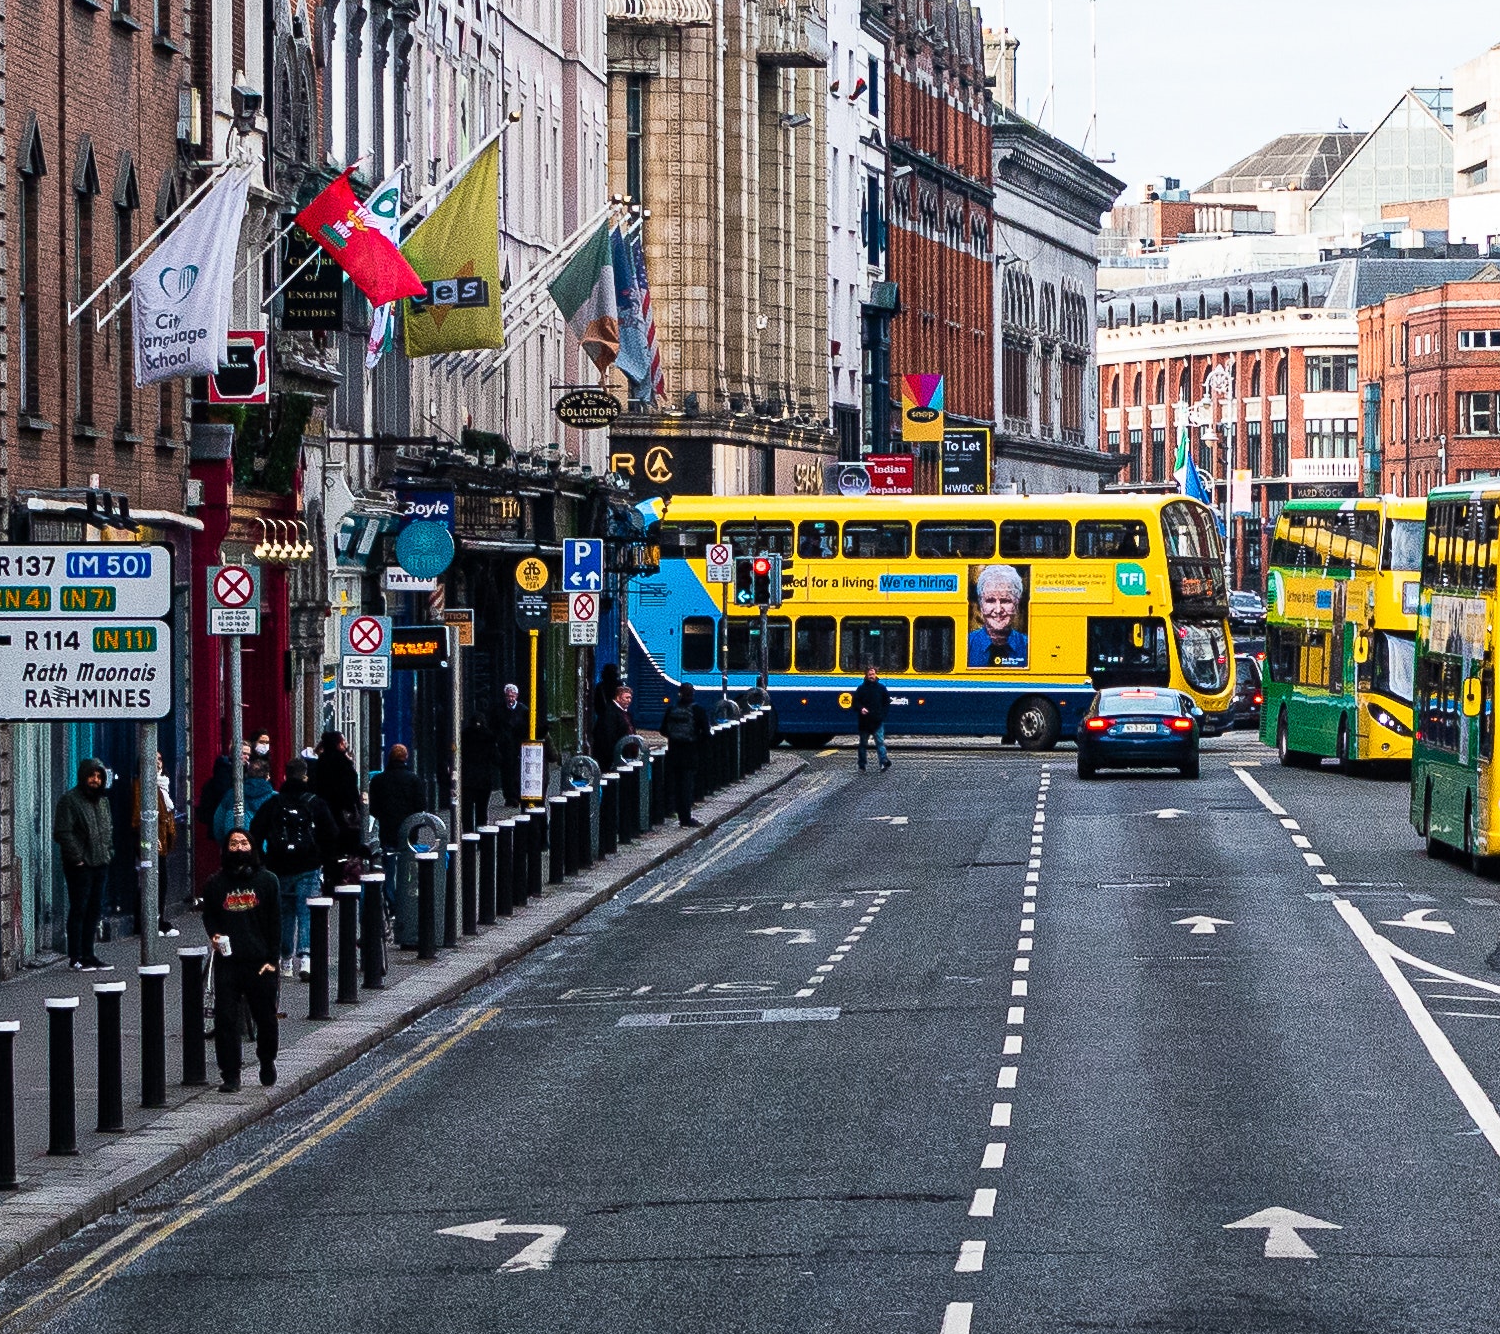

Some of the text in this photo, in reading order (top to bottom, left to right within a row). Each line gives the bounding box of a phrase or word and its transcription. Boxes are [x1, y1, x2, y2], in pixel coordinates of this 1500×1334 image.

[288, 291, 337, 300] ENGLISH
[289, 309, 336, 317] STUDIES
[140, 328, 208, 350] anguage
[560, 407, 618, 417] SOLICITORS
[944, 441, 959, 452] To
[962, 440, 981, 452] Let
[874, 465, 906, 474] Indian
[841, 474, 867, 488] City
[886, 477, 894, 485] &
[868, 486, 913, 495] Nepalese
[945, 483, 975, 493] HWBC
[1319, 489, 1344, 497] ROCK
[575, 541, 592, 566] P
[812, 576, 829, 589] for
[832, 579, 839, 589] a
[842, 576, 878, 591] living.
[880, 575, 915, 589] We're
[1119, 572, 1144, 586] TFI
[76, 661, 157, 682] Maonais
